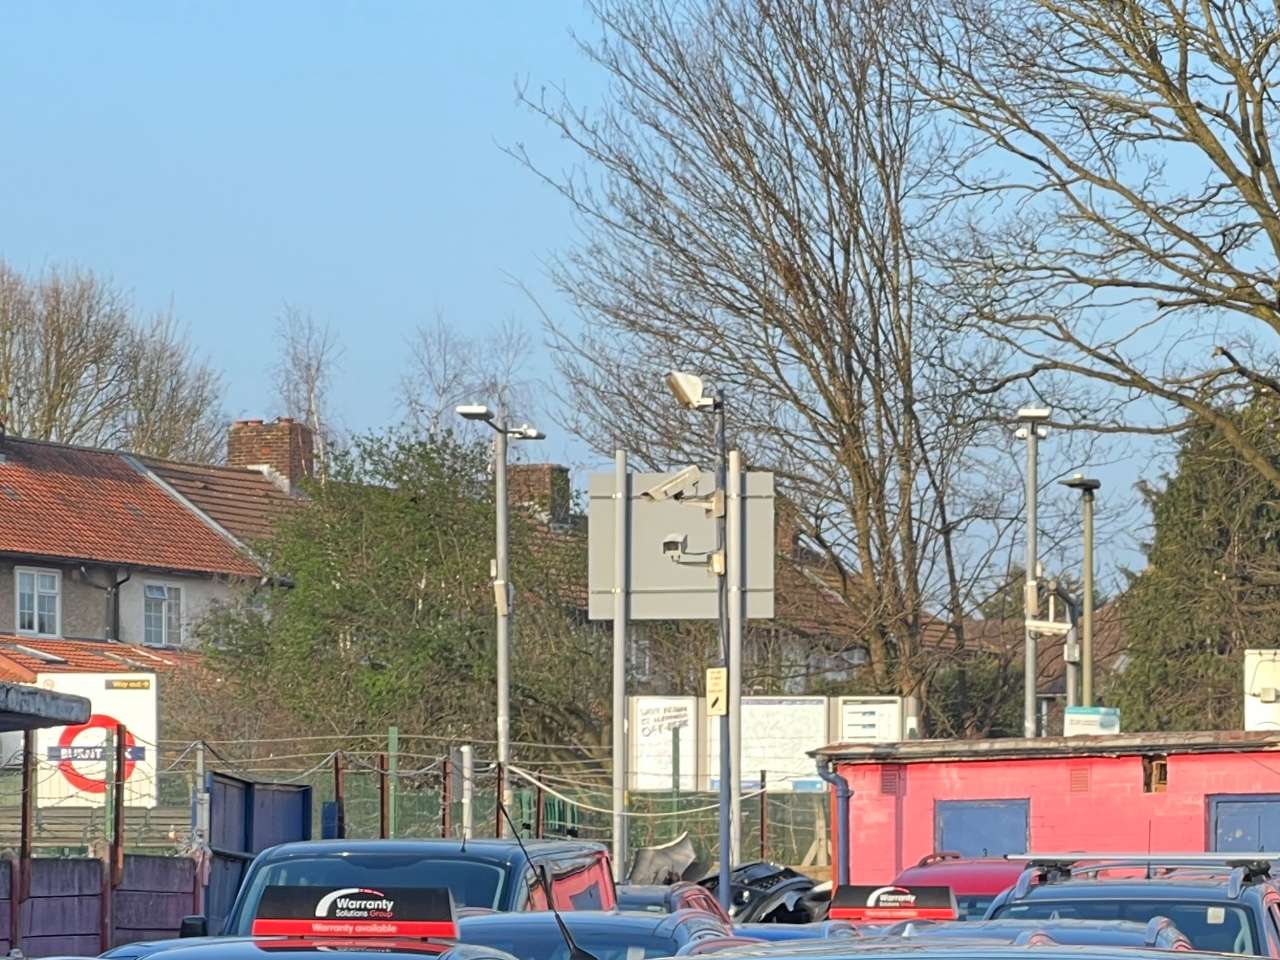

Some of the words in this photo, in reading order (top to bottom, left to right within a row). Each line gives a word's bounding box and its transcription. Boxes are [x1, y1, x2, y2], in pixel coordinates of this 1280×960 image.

[336, 898, 394, 912] Warranty
[335, 909, 368, 918] Solutions
[369, 909, 394, 919] Group
[311, 923, 355, 935] Warranty
[355, 923, 398, 933] available
